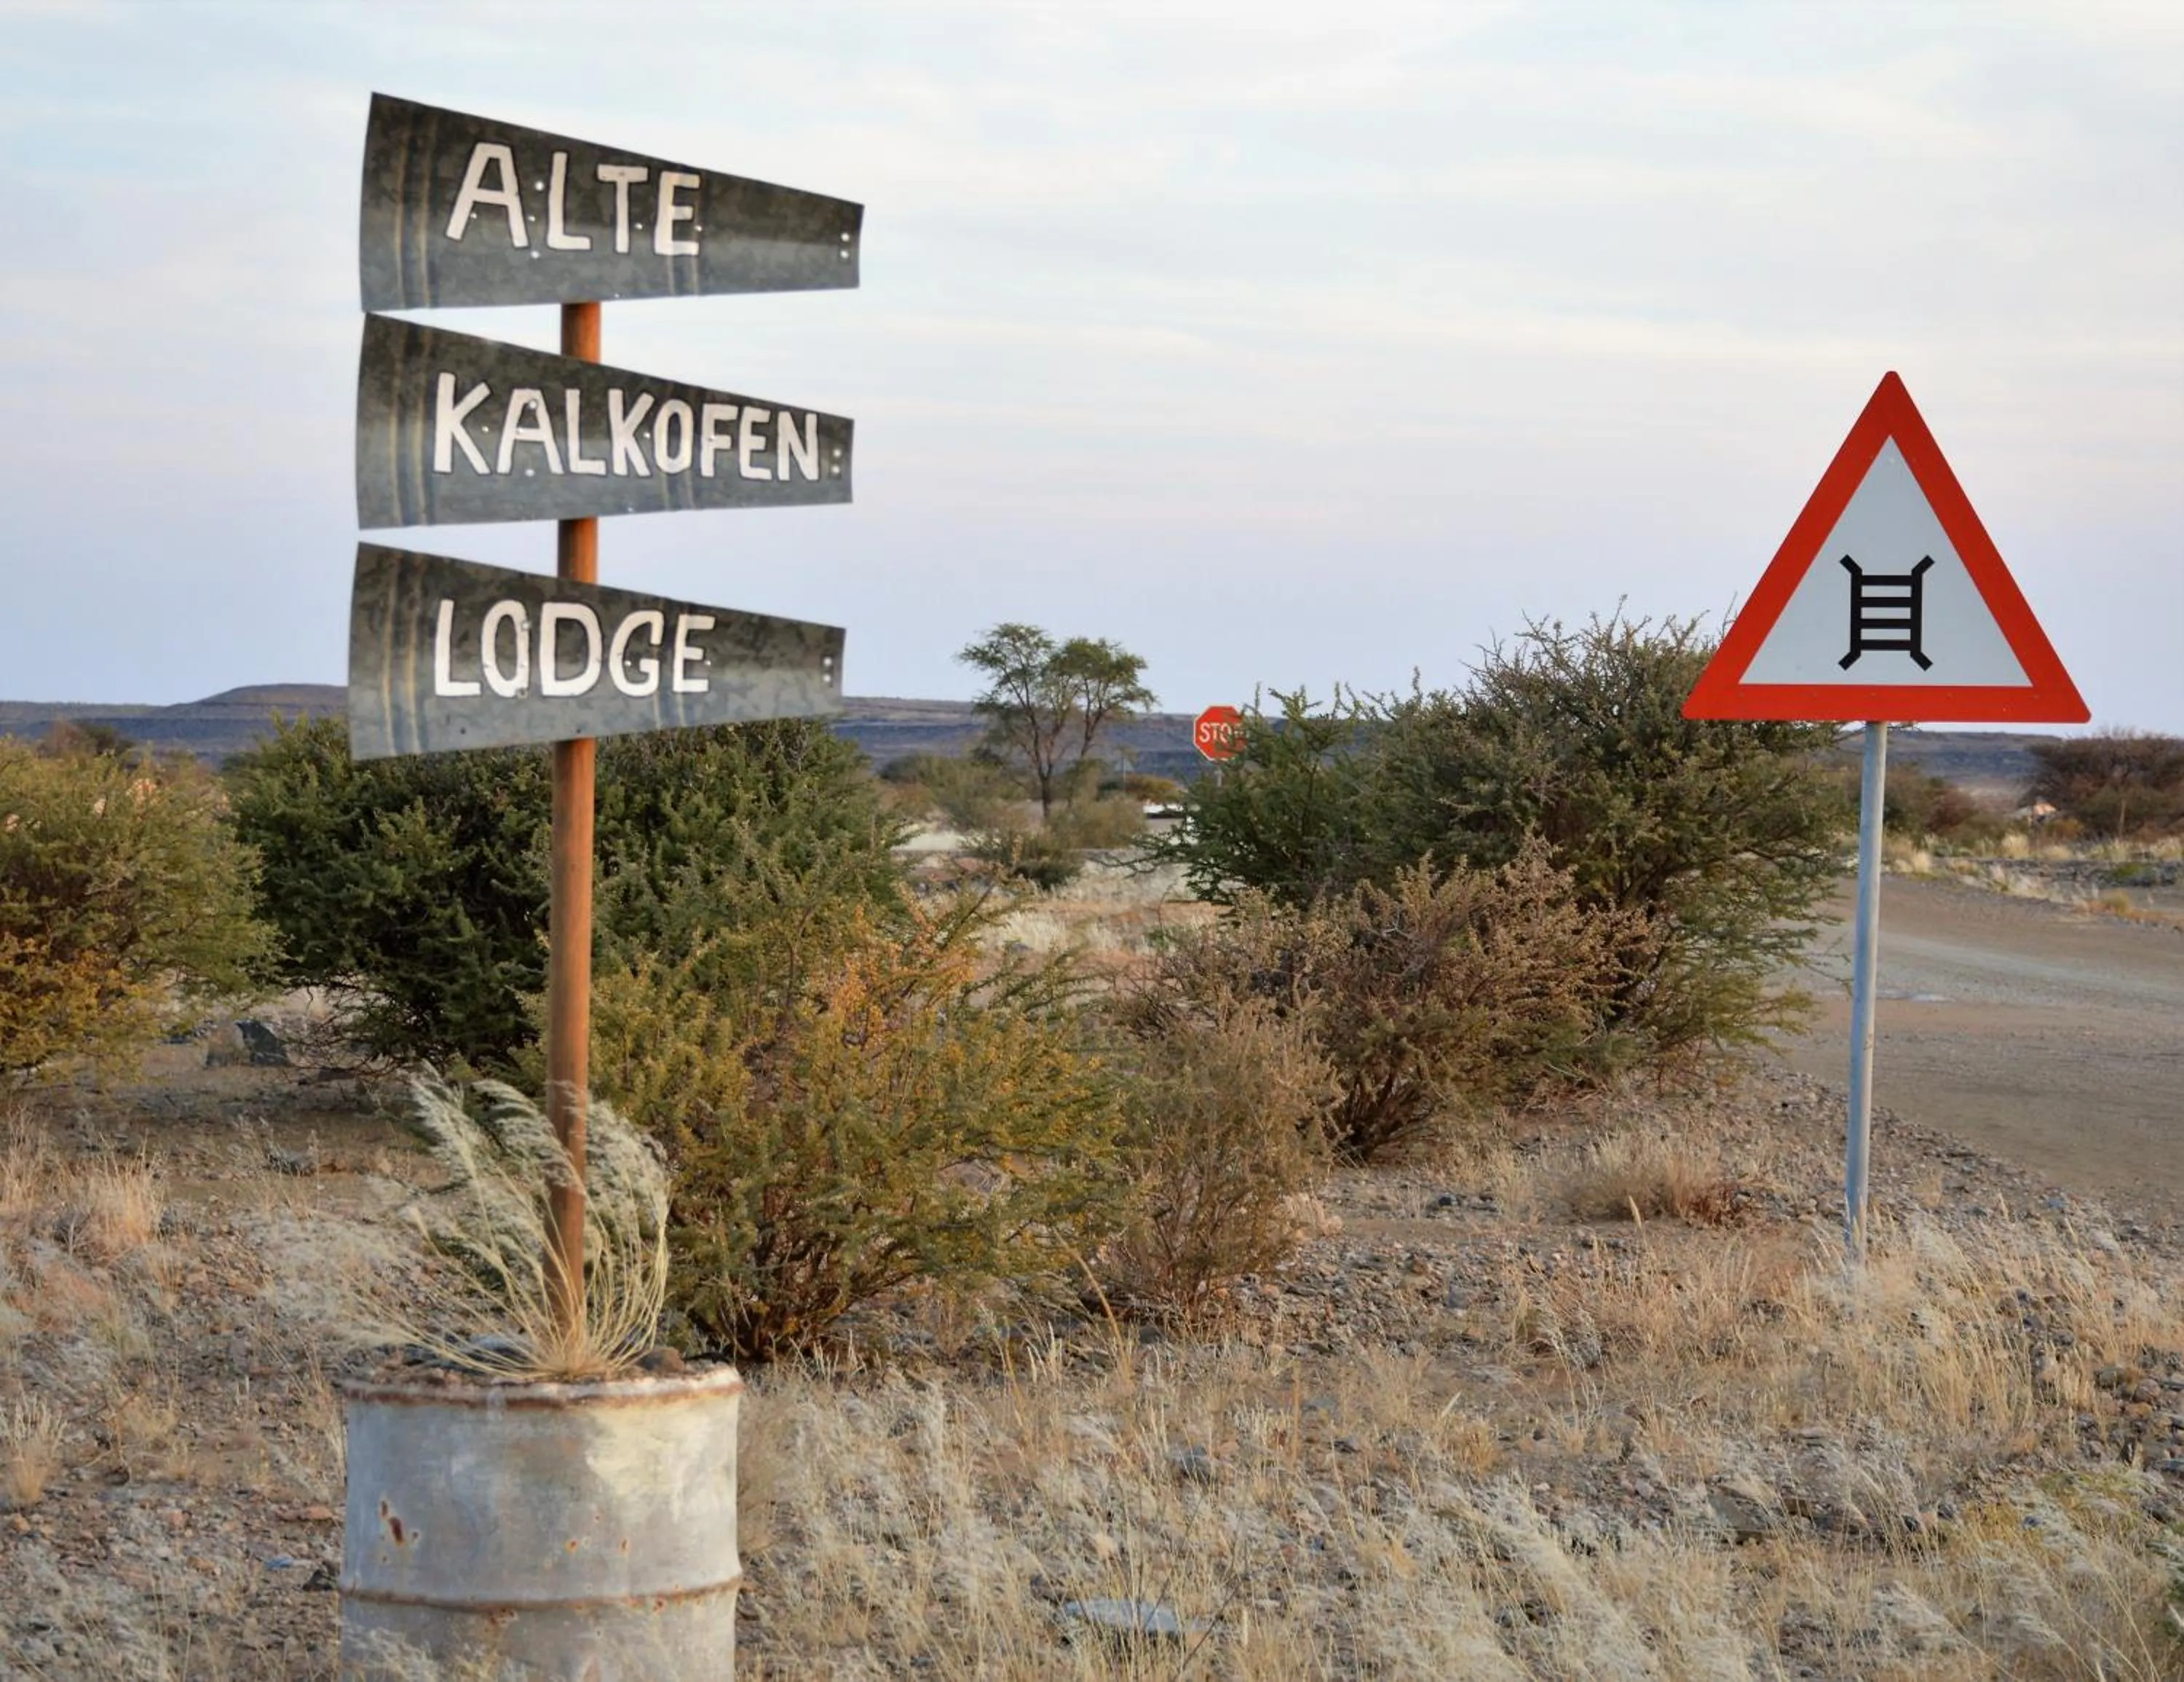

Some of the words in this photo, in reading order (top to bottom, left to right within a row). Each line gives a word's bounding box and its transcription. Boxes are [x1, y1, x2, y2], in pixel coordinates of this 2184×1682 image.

[446, 142, 701, 256] ALTE
[433, 372, 820, 481] KALKOFEN
[435, 599, 716, 698] LODGE
